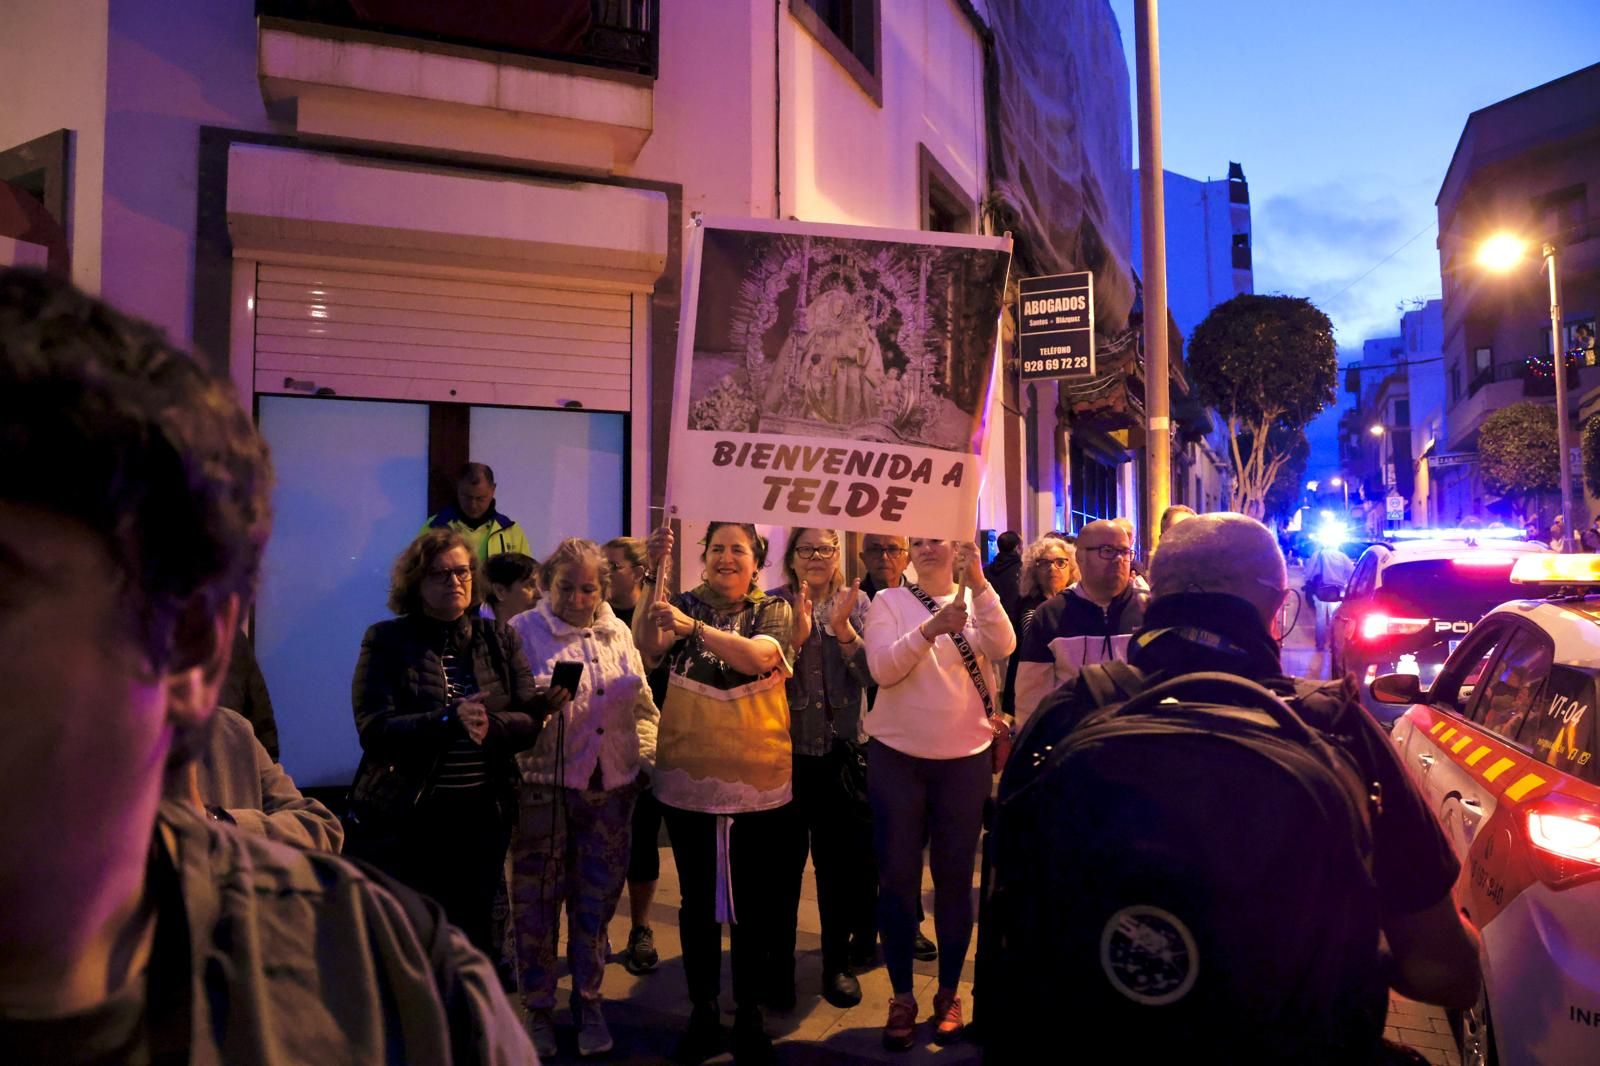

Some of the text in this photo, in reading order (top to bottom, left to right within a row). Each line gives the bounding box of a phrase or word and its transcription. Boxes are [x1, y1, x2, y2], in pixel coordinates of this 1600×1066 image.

[1024, 296, 1085, 315] ABOGADOS
[1040, 346, 1071, 355] TELÉFONO
[1024, 356, 1088, 373] 928 69 72 23
[712, 440, 964, 488] BIENVENIDA A
[762, 475, 913, 523] TELDE
[1548, 693, 1587, 726] VT-04
